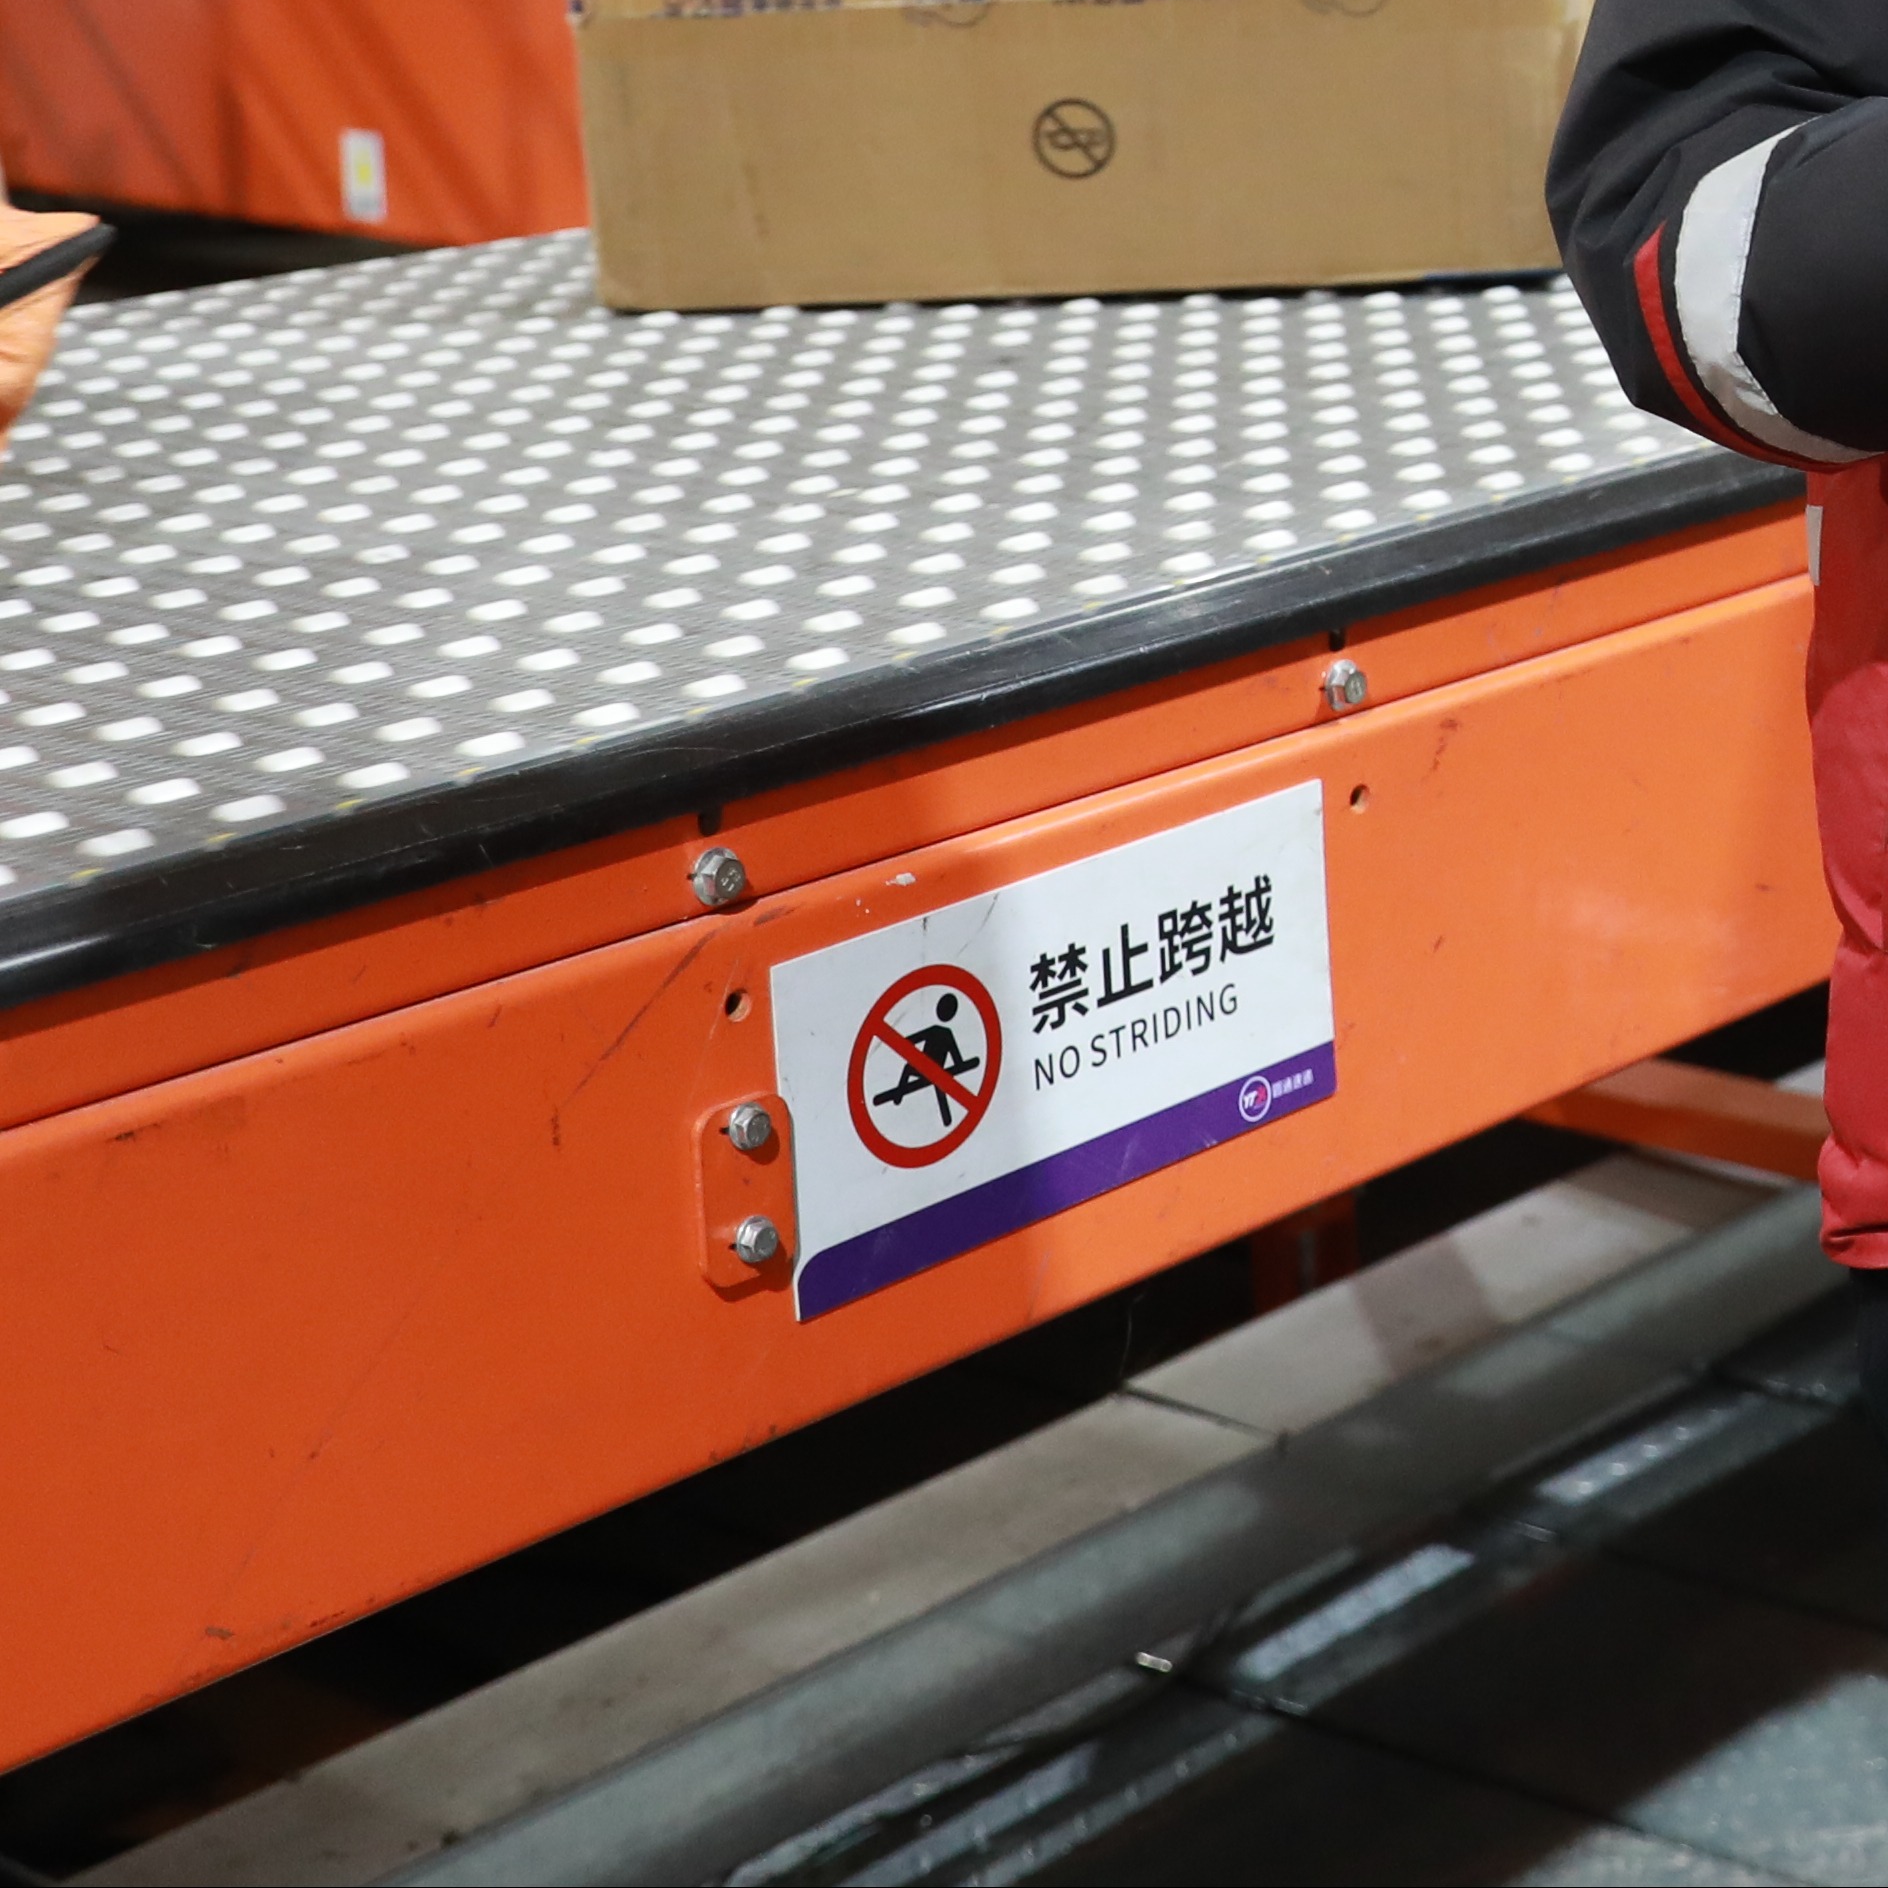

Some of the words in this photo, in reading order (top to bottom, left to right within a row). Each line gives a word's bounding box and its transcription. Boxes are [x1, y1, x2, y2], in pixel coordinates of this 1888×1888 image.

[1029, 874, 1275, 1034] 禁止跨越
[1034, 1044, 1080, 1091] NO
[1090, 983, 1239, 1067] STRIDING
